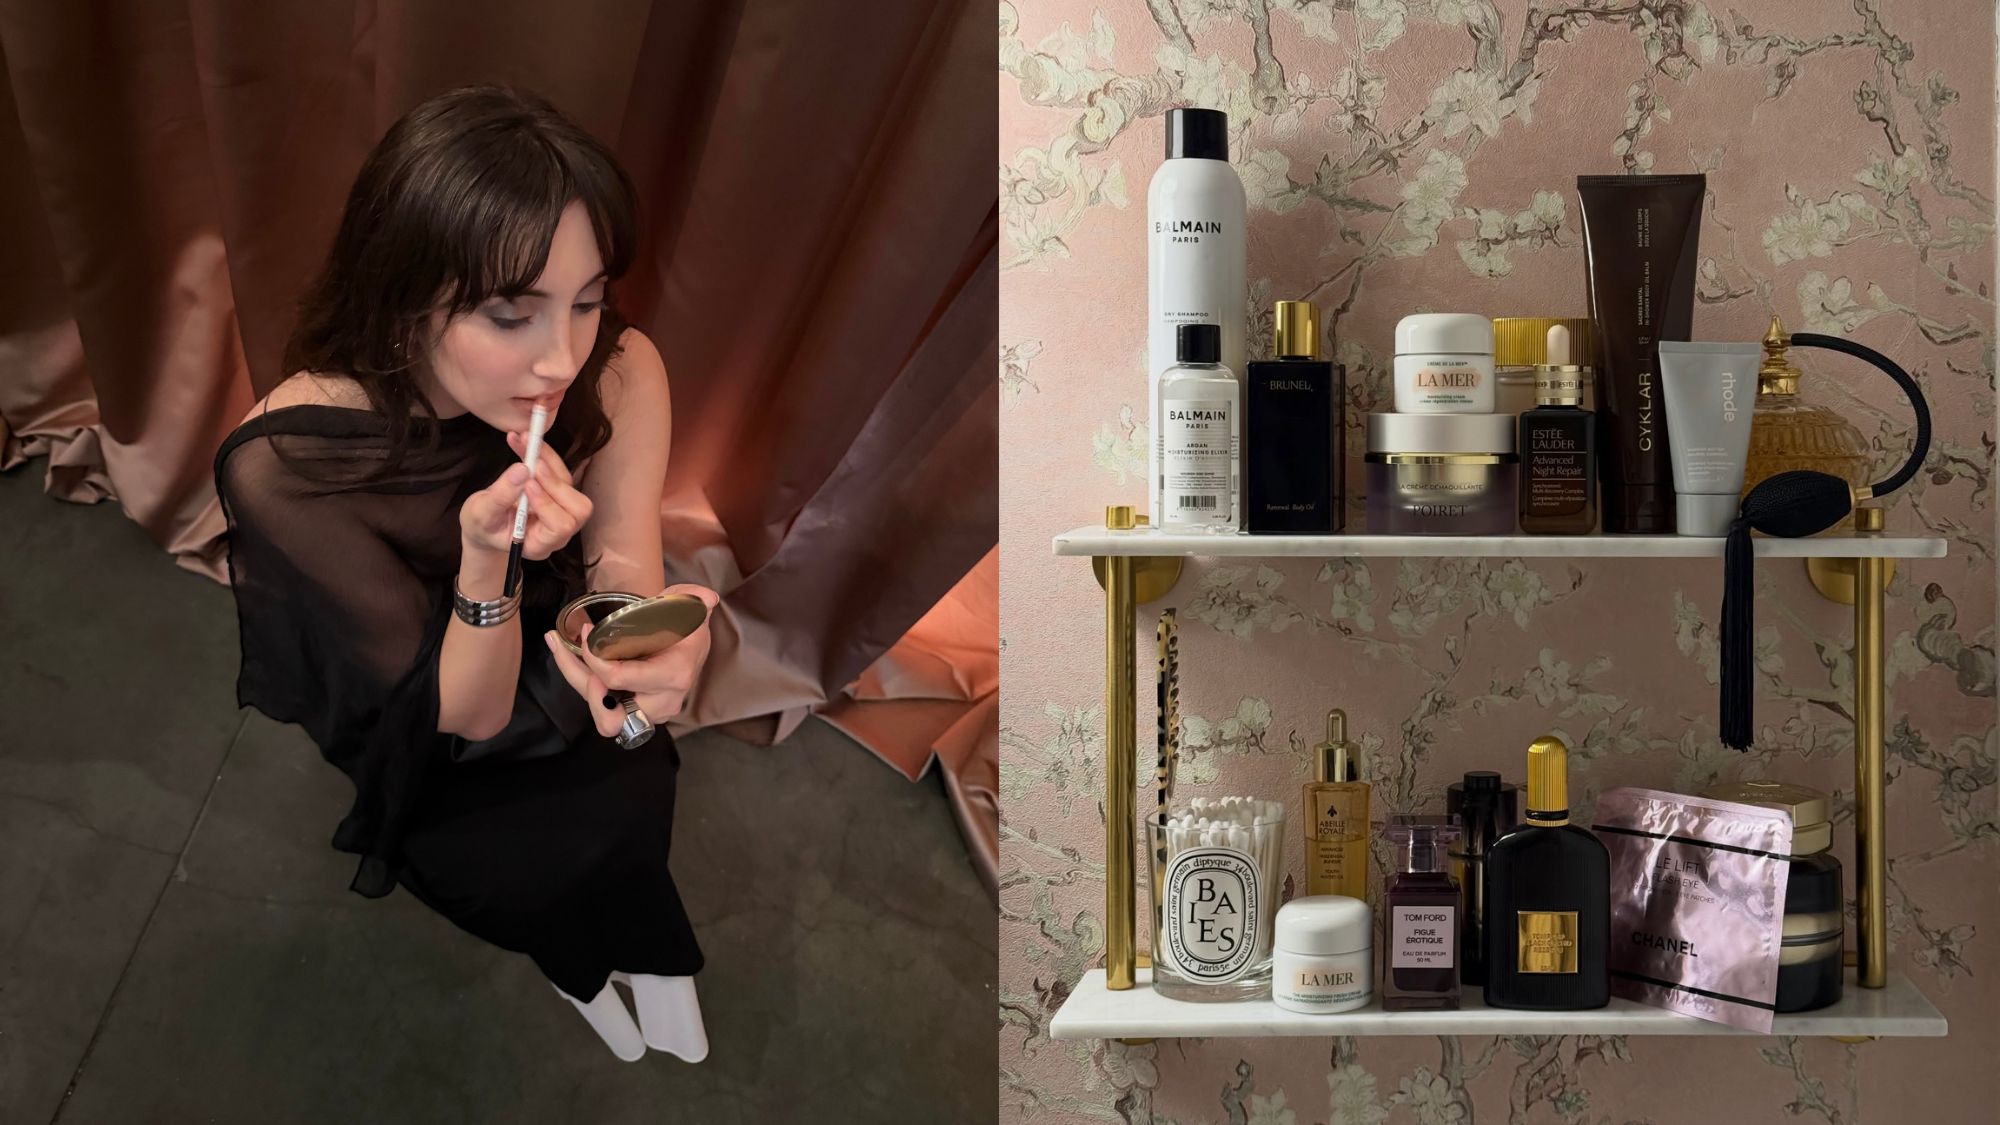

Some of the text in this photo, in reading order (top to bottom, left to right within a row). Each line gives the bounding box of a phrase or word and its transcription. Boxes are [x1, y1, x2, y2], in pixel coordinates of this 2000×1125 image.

[1155, 221, 1221, 234] BALMAIN
[1172, 236, 1200, 244] PARIS
[1417, 373, 1475, 387] LA MER
[1721, 372, 1738, 422] rhode
[1169, 410, 1227, 421] BALMAIN
[1638, 372, 1652, 452] CYKLAR
[1532, 439, 1575, 450] LAUDER
[1532, 455, 1574, 465] Advanced
[1532, 466, 1583, 478] Night Repair
[1412, 504, 1468, 518] POIRET
[1193, 858, 1232, 868] diptyque
[1656, 856, 1701, 875] LE LIFT
[1172, 863, 1191, 894] germain
[1682, 878, 1700, 889] EYE
[1403, 914, 1447, 922] TOM FORD
[1406, 936, 1444, 944] ÉROTIQUE
[1631, 931, 1698, 957] CHANEL
[1301, 972, 1354, 987] LA MER
